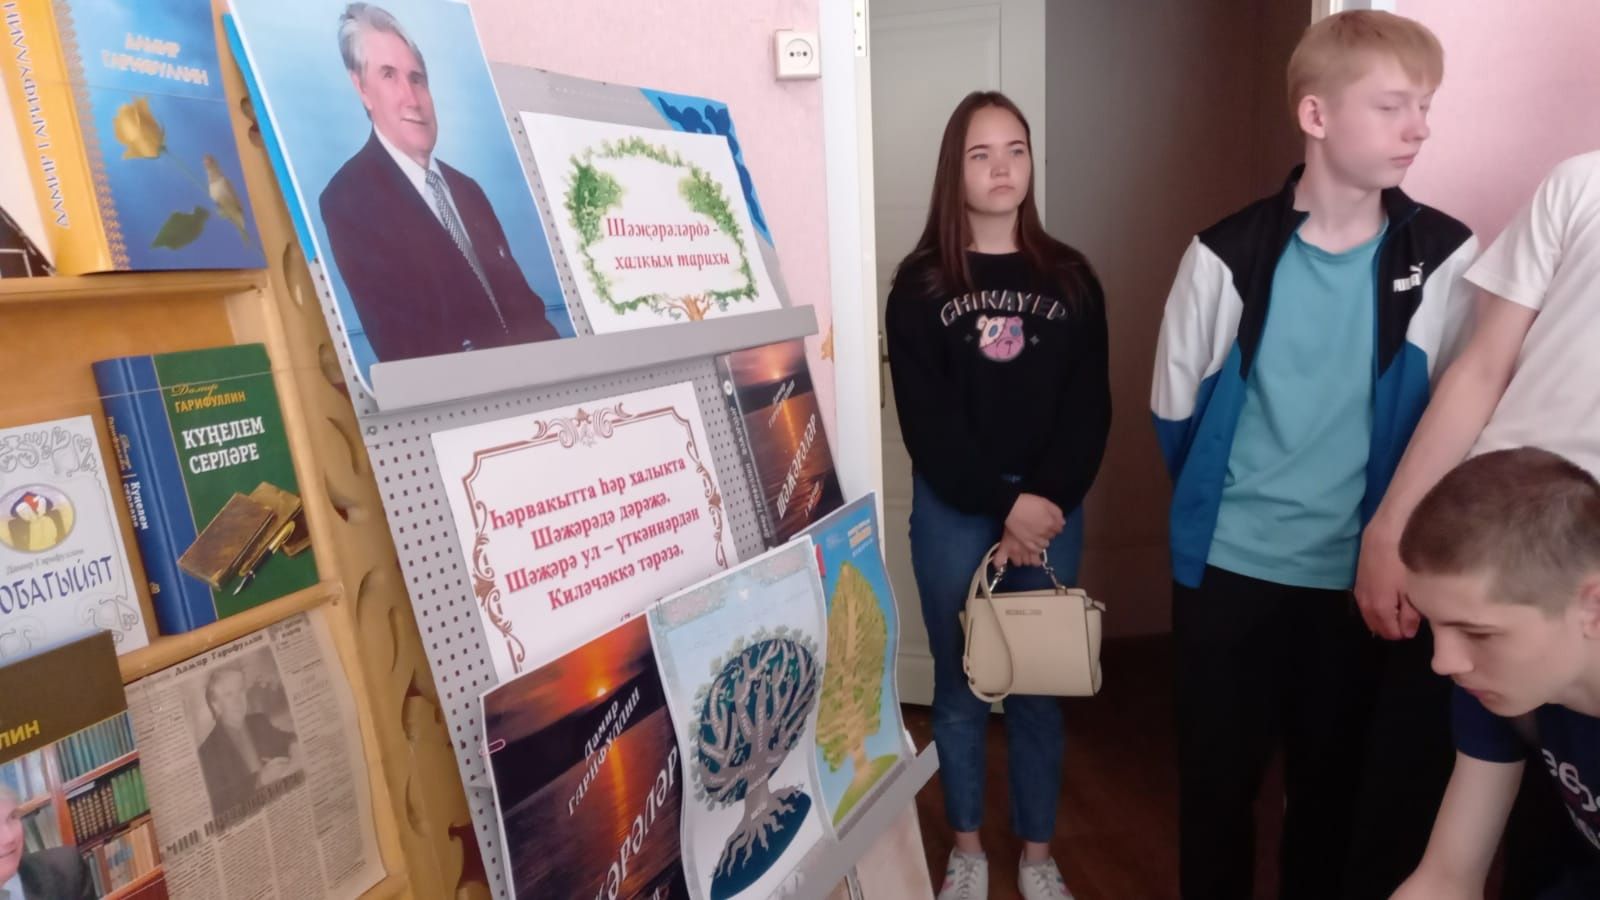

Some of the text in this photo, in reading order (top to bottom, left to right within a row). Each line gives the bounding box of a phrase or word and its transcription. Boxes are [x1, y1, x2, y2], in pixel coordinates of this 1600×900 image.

[615, 252, 730, 270] халкым тарихы
[175, 391, 246, 413] ГАРИФУЛЛИН
[181, 416, 265, 449] КҮҢЕЛЕМ
[189, 443, 260, 475] СЕРЛӘРЕ
[488, 457, 686, 530] Һәрвакытта һәр халыкта
[581, 548, 601, 569] ул
[547, 562, 635, 610] Киләчәккә
[567, 686, 640, 817] ГАРИФУЛЛИН
